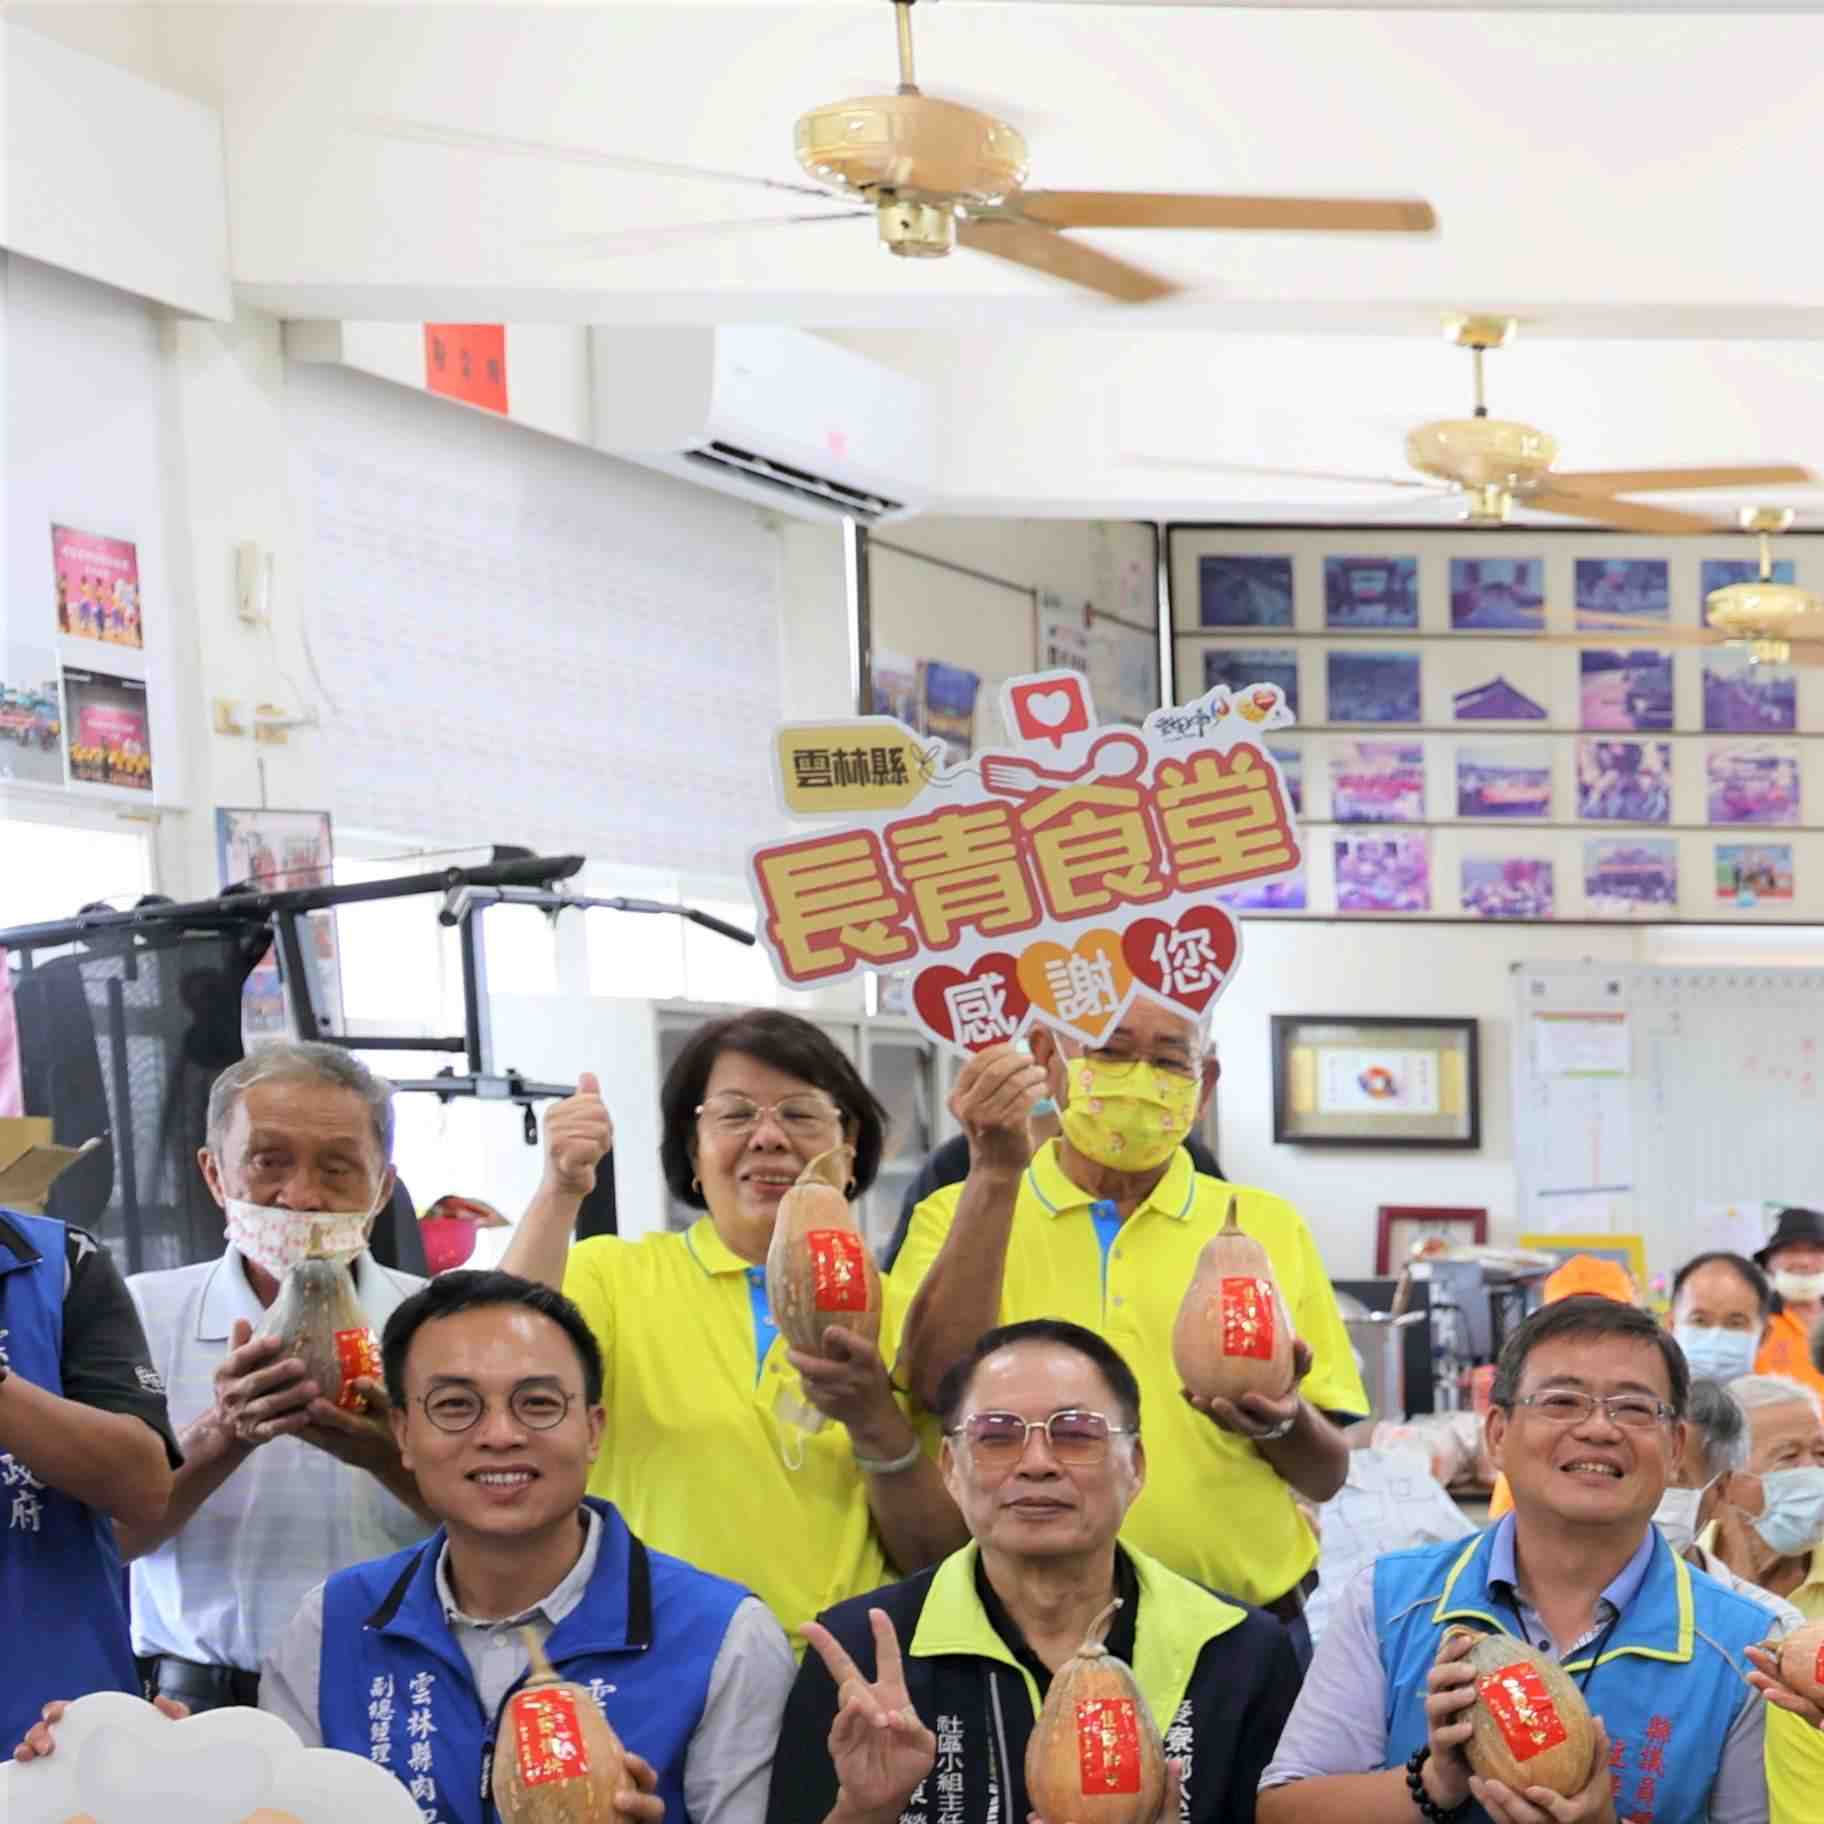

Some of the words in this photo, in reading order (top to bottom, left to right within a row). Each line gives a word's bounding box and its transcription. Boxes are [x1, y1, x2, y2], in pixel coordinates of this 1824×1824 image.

[793, 746, 909, 789] 雲林縣
[758, 750, 1291, 975] 長青食堂
[945, 926, 1224, 1049] 感謝您
